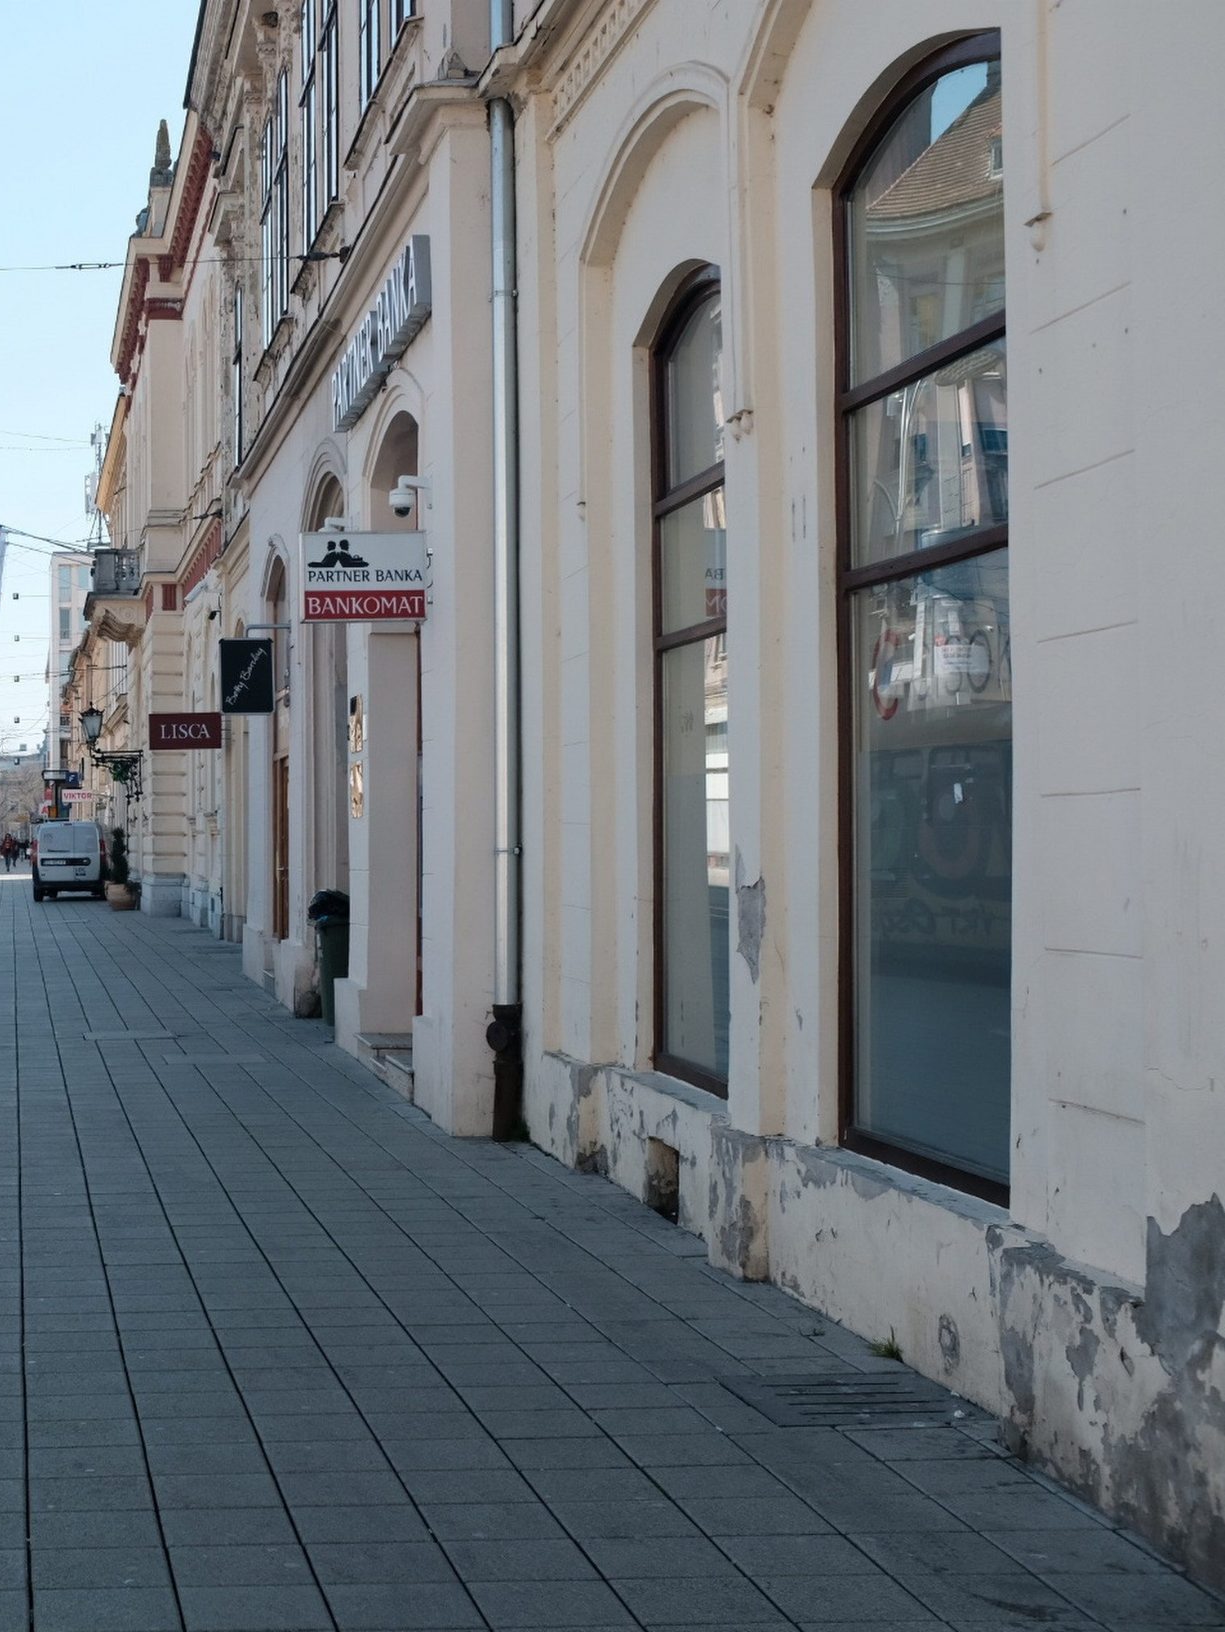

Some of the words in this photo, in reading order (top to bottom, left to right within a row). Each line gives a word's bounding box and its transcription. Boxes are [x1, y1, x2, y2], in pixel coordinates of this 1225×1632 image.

[332, 311, 374, 432] PARTNER
[377, 235, 417, 364] BANKA
[307, 569, 370, 582] PARTNER
[375, 569, 423, 582] BANKA
[307, 596, 423, 615] BANKOMAT
[160, 723, 211, 739] LISCA
[63, 792, 92, 800] VIKTOR
